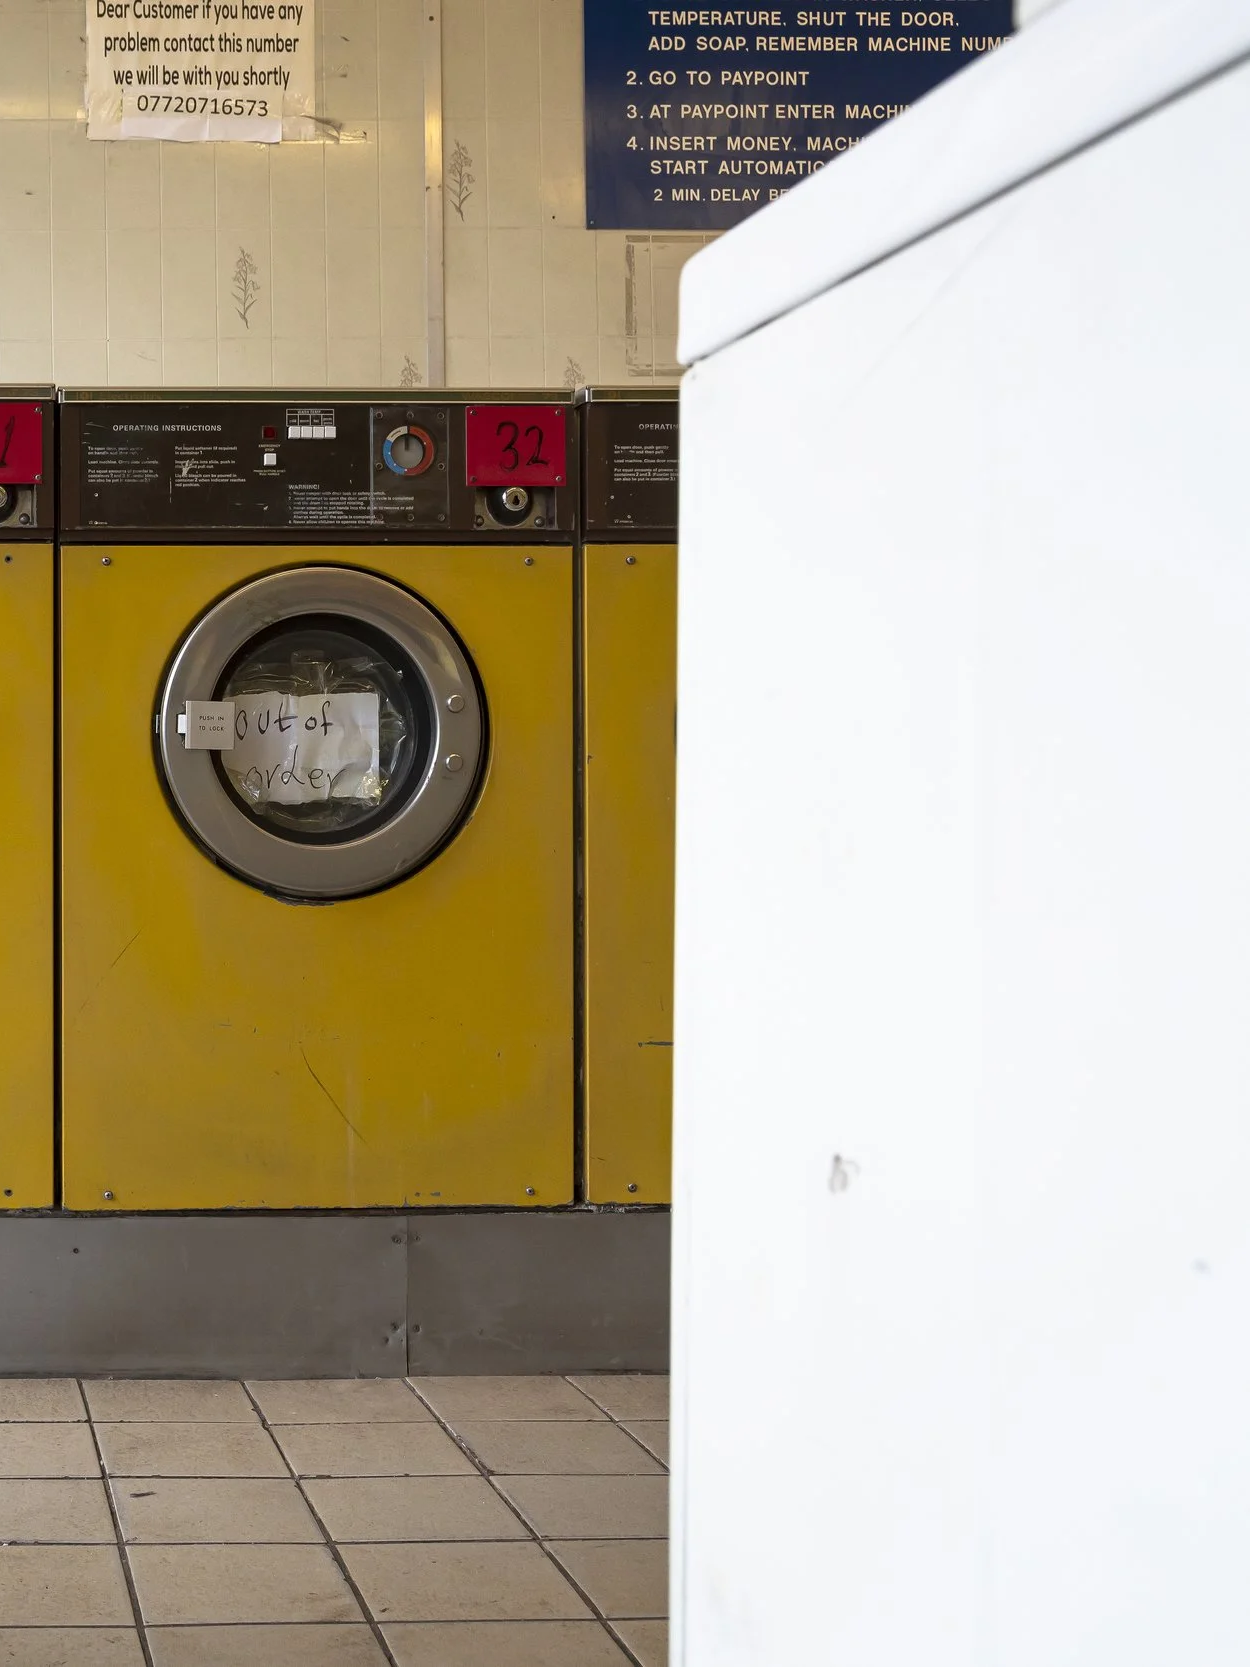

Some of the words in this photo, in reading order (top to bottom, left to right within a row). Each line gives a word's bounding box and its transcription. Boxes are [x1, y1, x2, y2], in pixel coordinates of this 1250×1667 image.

[96, 0, 130, 19] Dear
[133, 0, 198, 19] Customer
[202, 0, 211, 19] if
[214, 4, 238, 25] you
[241, 0, 274, 20] have
[279, 4, 303, 25] any
[796, 11, 847, 27] SHUT
[856, 11, 891, 27] THE
[104, 32, 160, 57] problem
[164, 36, 215, 53] contact
[218, 33, 242, 53] this
[246, 34, 299, 52] number
[648, 36, 686, 51] ADD
[755, 36, 858, 52] REMEMBER
[868, 37, 951, 52] MACHINE
[113, 69, 133, 85] we
[136, 65, 159, 85] will
[163, 65, 179, 86] be
[183, 65, 212, 86] with
[215, 69, 239, 90] you
[243, 66, 290, 90] shortly
[626, 71, 643, 86] 2.
[648, 71, 677, 86] GO
[686, 71, 711, 86] TO
[720, 71, 810, 86] PAYPOINT
[137, 95, 269, 116] 07720716573
[626, 104, 644, 120] 3.
[649, 104, 669, 120] AT
[680, 104, 769, 120] PAYPOINT
[775, 104, 835, 120] ENTER
[626, 136, 644, 152] 4.
[649, 136, 717, 152] INSERT
[650, 160, 709, 176] START
[653, 188, 663, 202] 2
[671, 188, 706, 202] MIN.
[710, 188, 760, 202] DELAY
[112, 424, 159, 432] OPERATING
[162, 424, 222, 432] INSTRUCTIONS
[496, 420, 549, 472] 32
[304, 701, 334, 736] of
[245, 745, 347, 790] order
